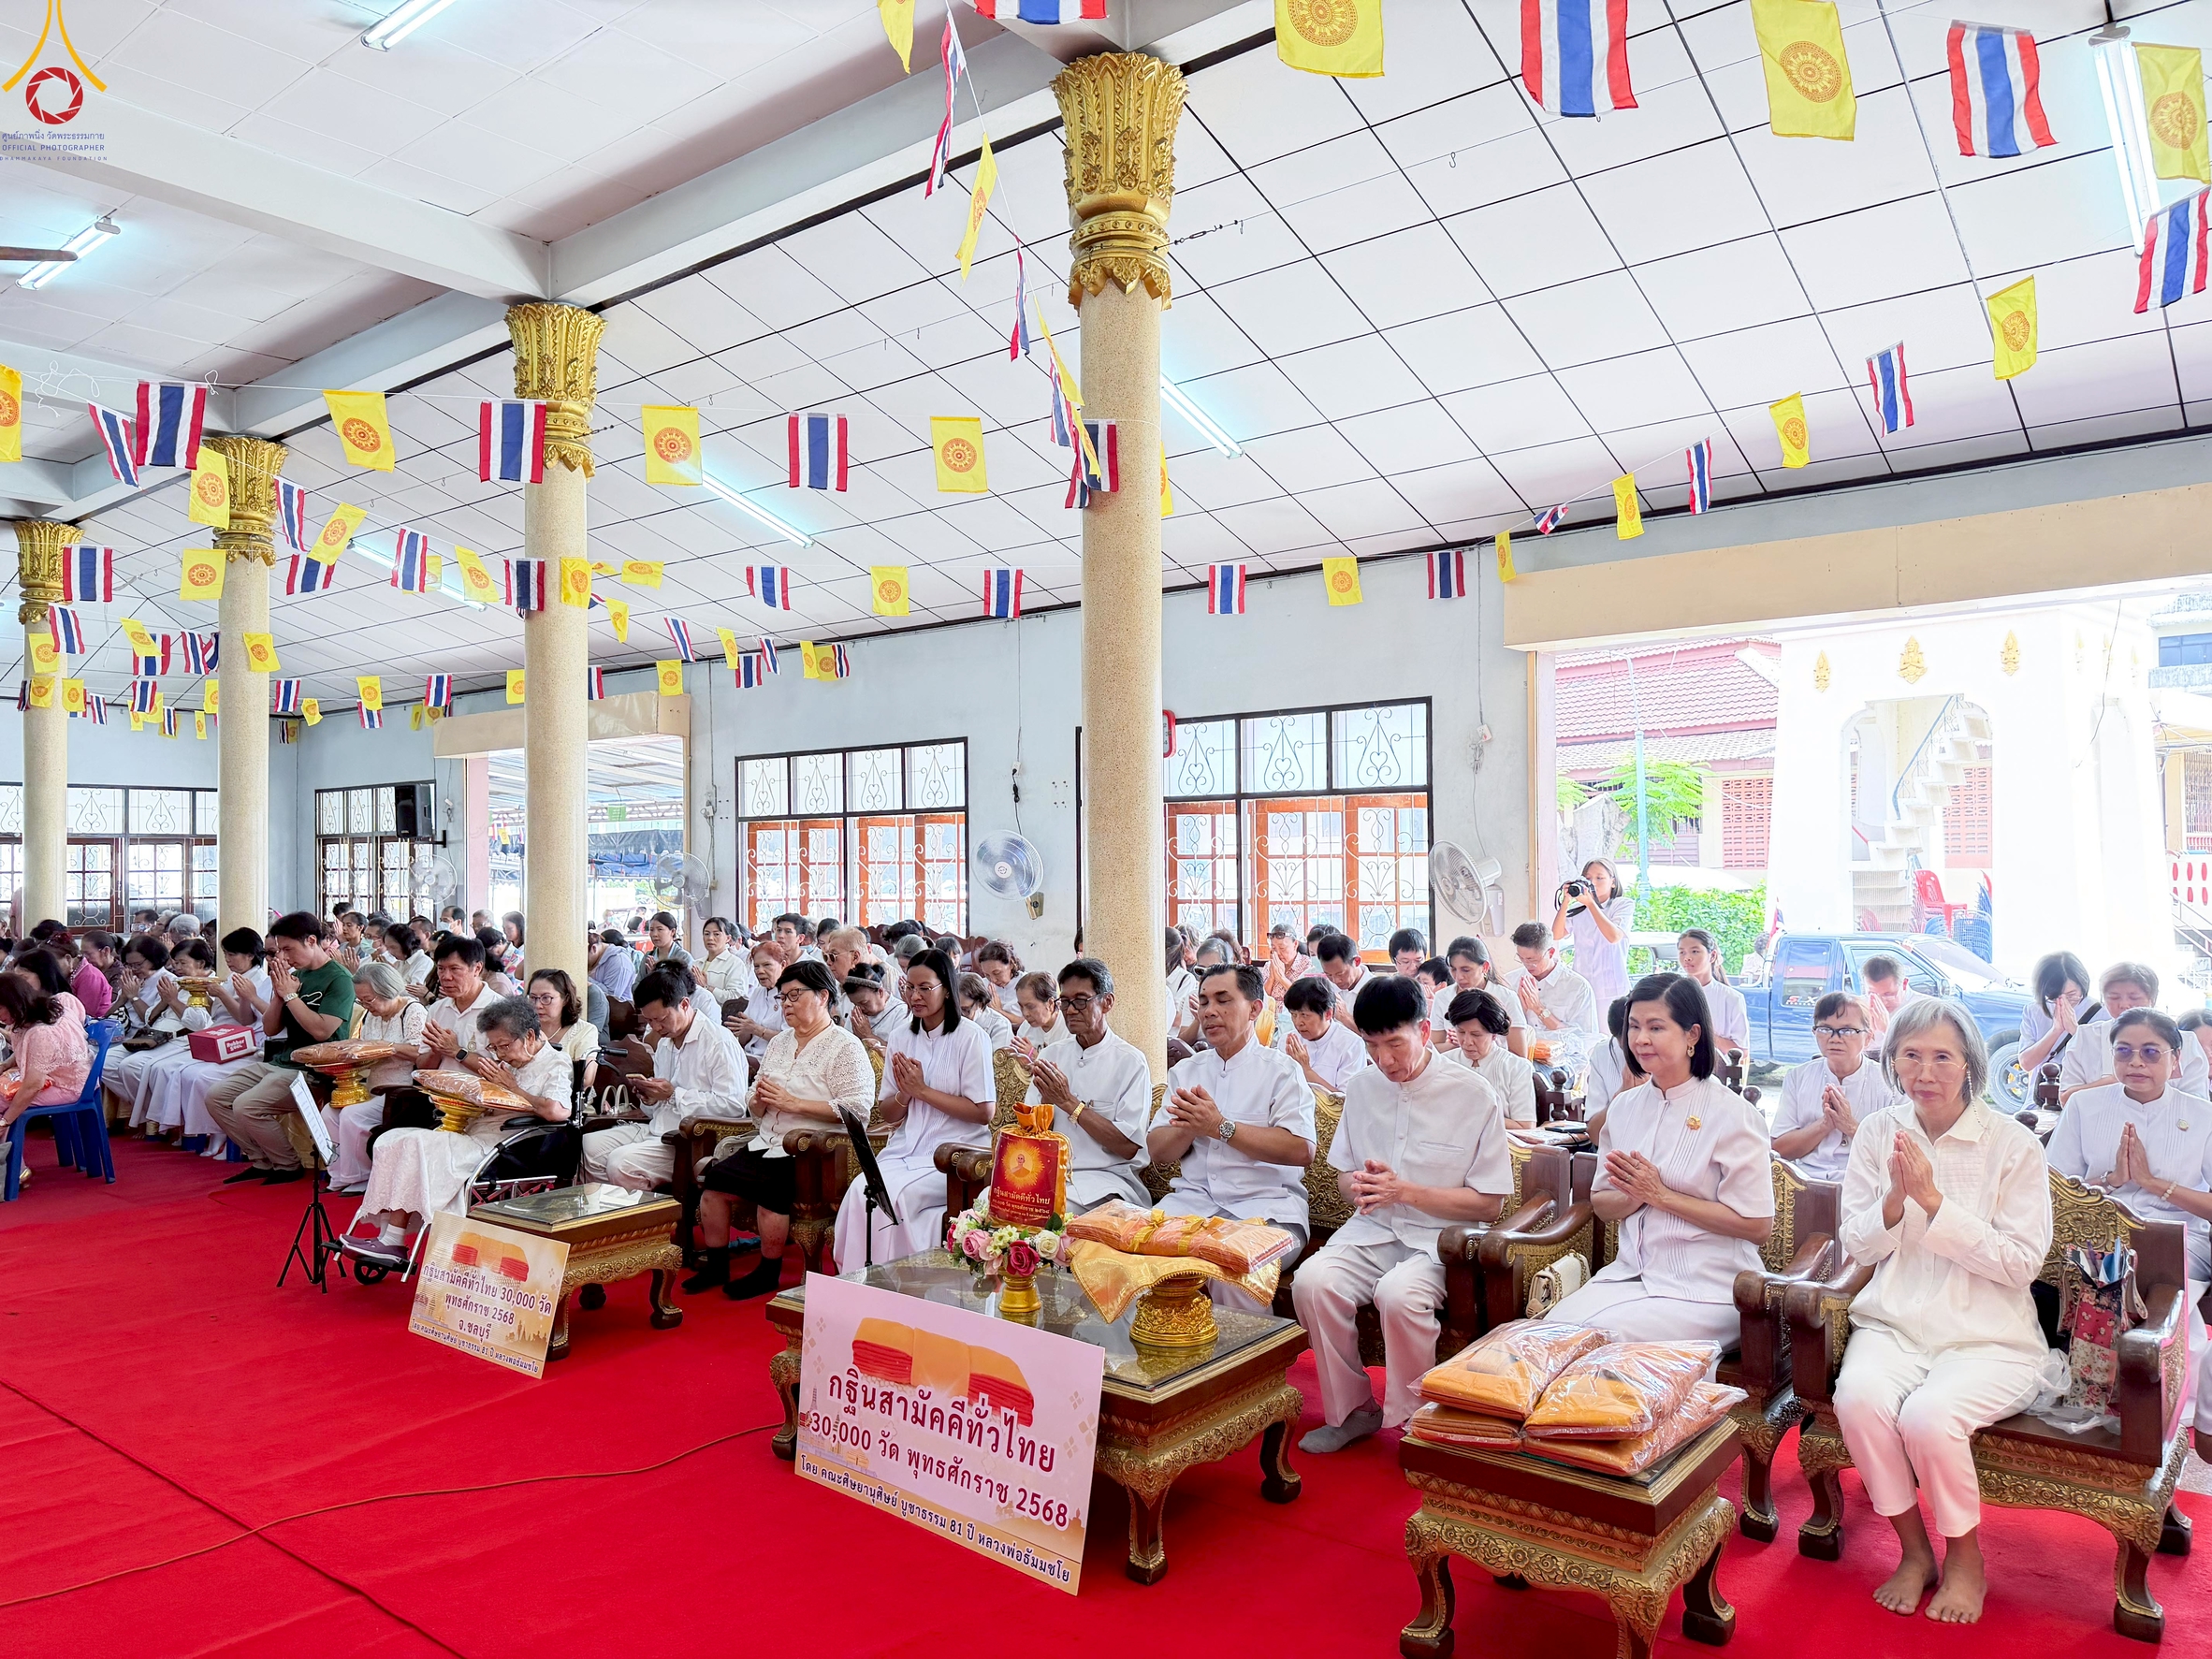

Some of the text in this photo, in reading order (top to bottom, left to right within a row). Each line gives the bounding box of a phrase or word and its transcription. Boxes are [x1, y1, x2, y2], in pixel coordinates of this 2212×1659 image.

[445, 1293, 515, 1325] พุทธศักราช 2568
[501, 1288, 535, 1309] 30,000
[539, 1295, 552, 1315] วัด
[811, 1412, 1069, 1527] 30,000 วัด พุทธศักราช 2568
[829, 1368, 1055, 1473] กฐินสามัคคีทั่วไทย
[801, 1454, 1070, 1582] โดย คณะศิษยานุศิษย์ บูชาธรรม 81 ปี หลวงพ่อธัมมชโย
